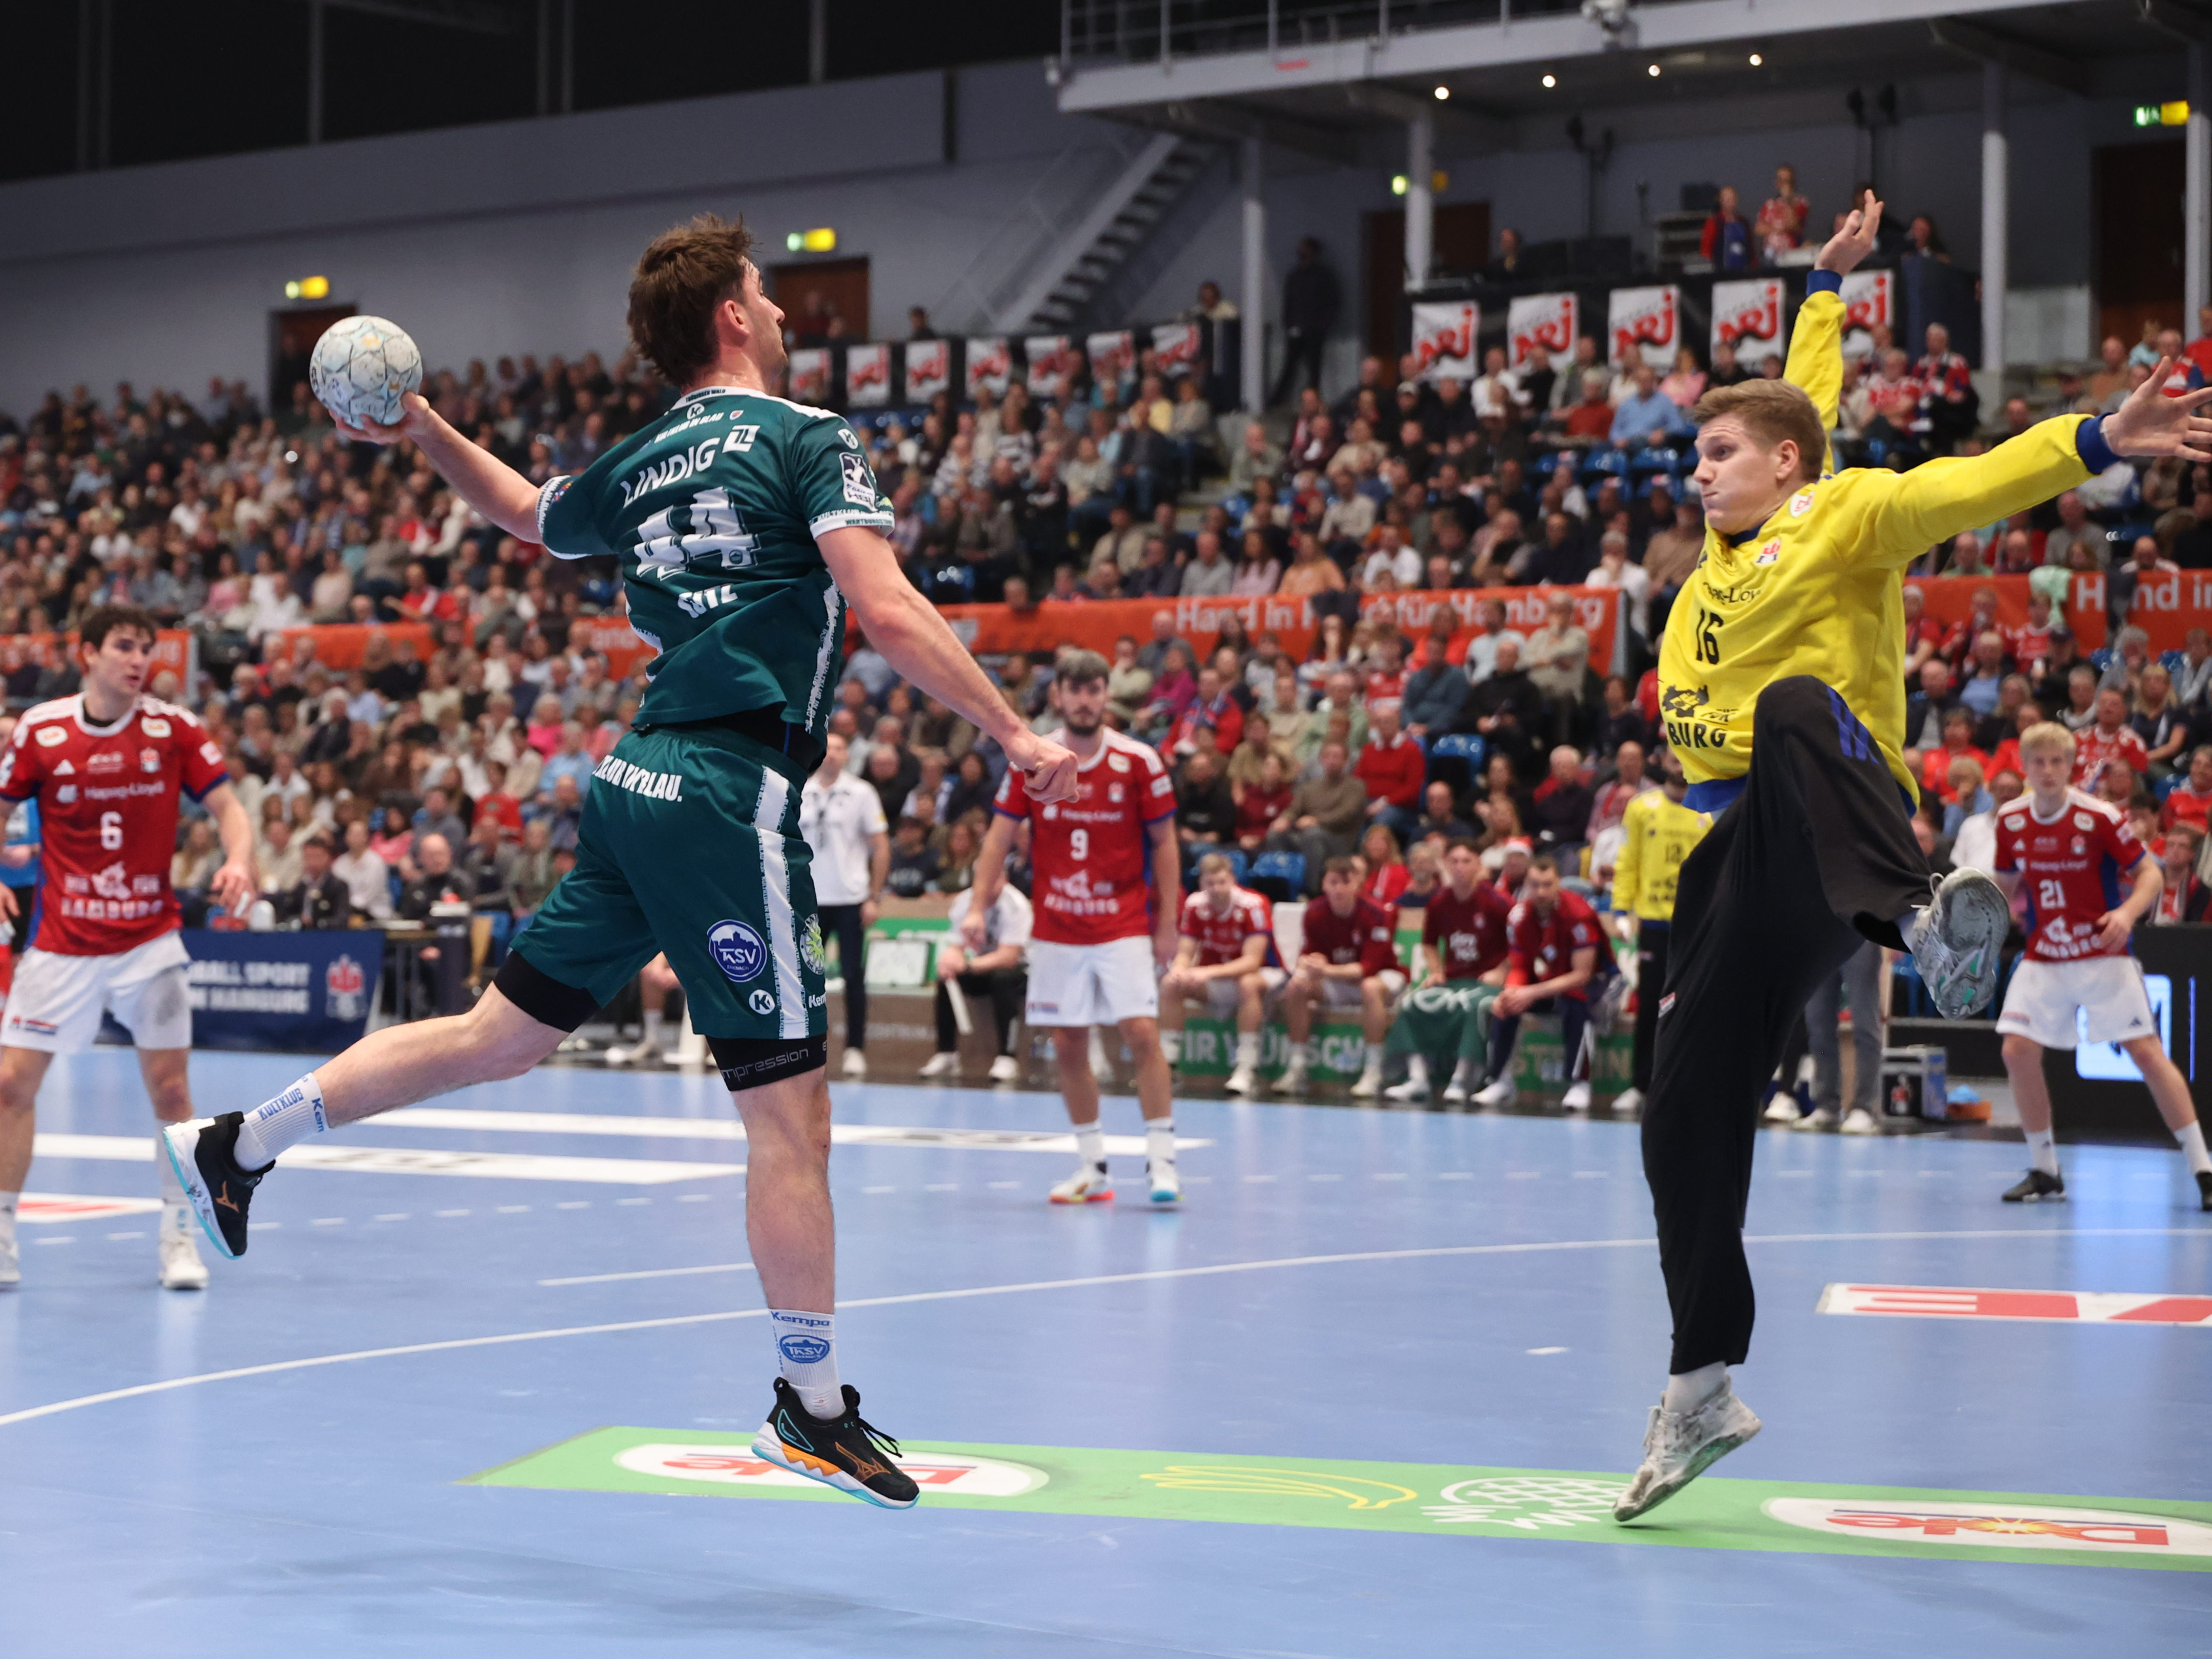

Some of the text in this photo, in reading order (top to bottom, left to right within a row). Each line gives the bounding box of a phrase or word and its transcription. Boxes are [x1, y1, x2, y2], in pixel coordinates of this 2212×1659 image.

[620, 437, 720, 508] LINDIG
[634, 486, 761, 582] 44
[2076, 575, 2180, 611] Hnd
[1695, 607, 1725, 666] 16
[1668, 722, 1728, 748] BURG
[100, 811, 123, 851] 6
[1069, 828, 1089, 862] 9
[2039, 879, 2066, 909] 21
[257, 1088, 304, 1120] KULTKLUB
[771, 1310, 830, 1327] Kempa
